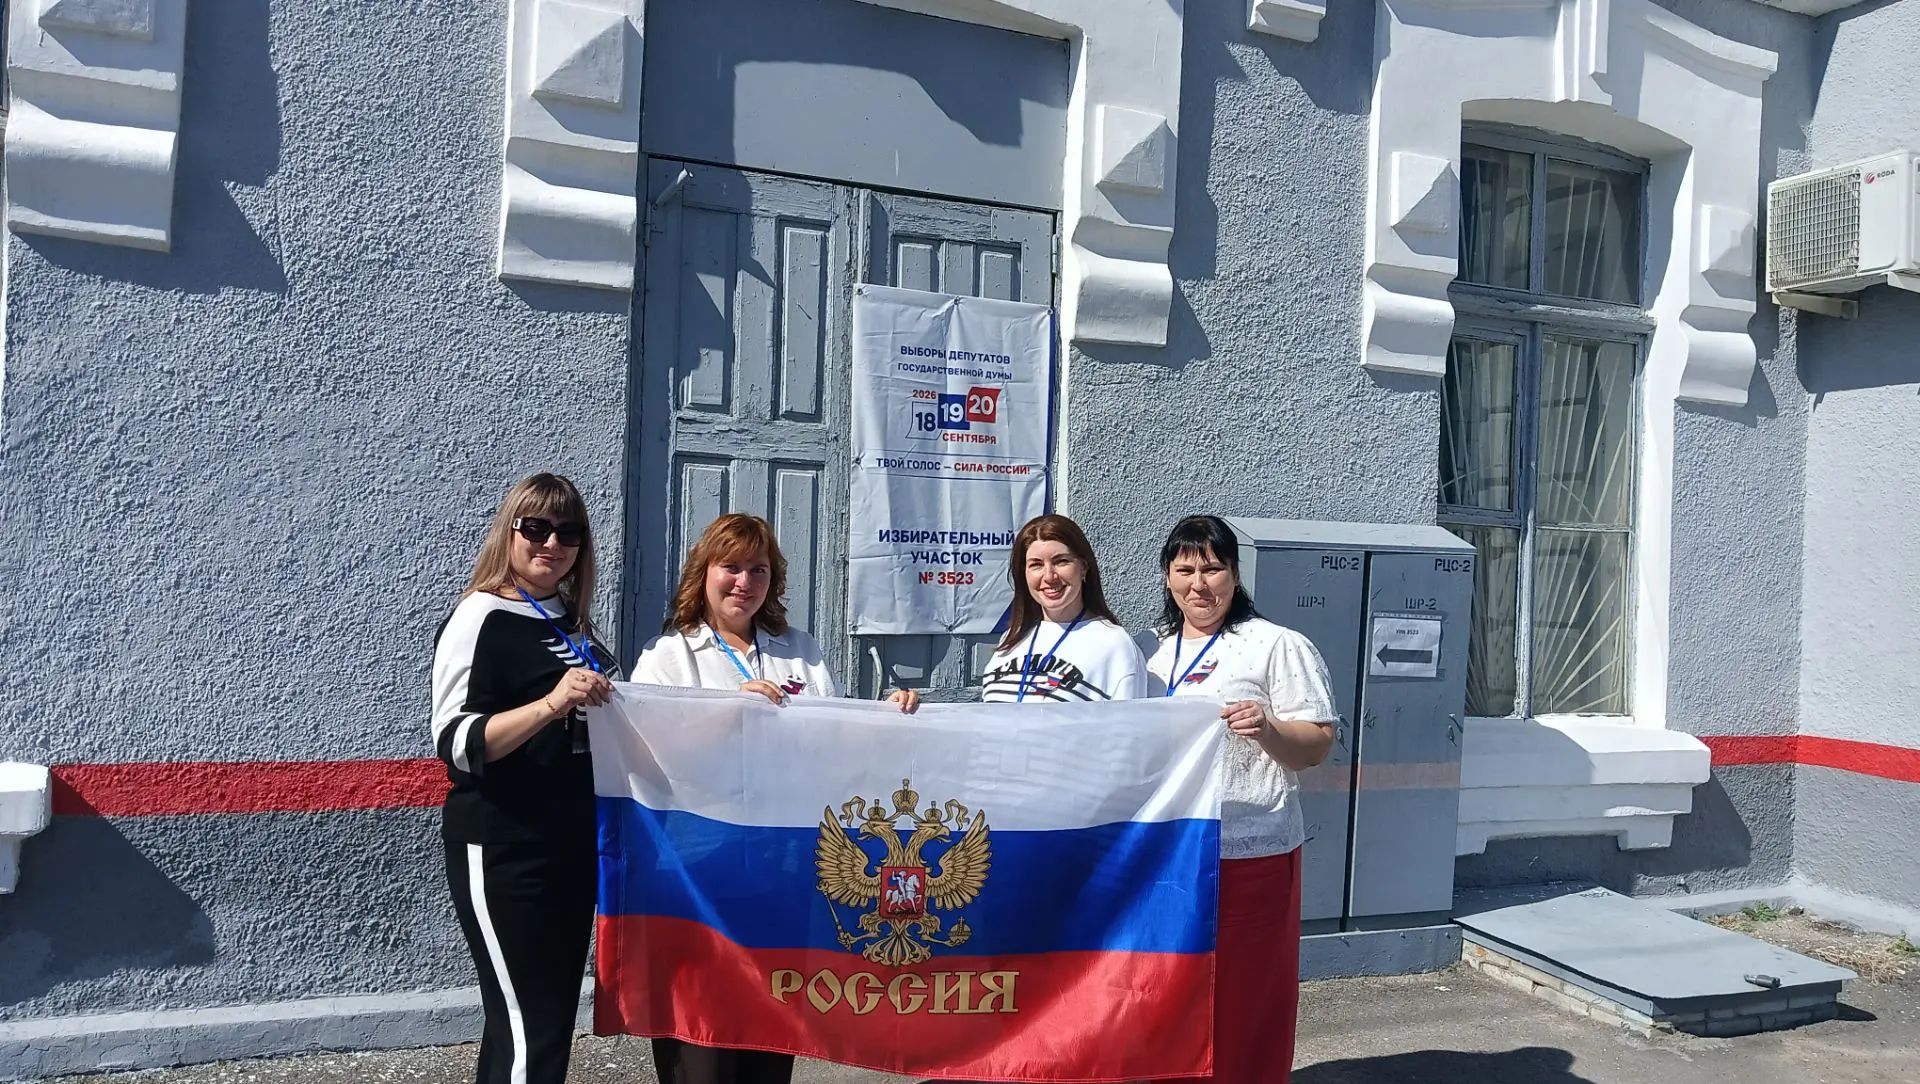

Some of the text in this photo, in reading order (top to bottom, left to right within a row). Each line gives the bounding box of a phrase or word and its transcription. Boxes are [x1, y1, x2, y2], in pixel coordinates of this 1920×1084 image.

[901, 346, 1010, 364] ВЫБОРЫ ДЕПУТАТОВ
[898, 363, 1012, 380] ГОСУДАРСТВЕННОЙ ДУМЫ
[912, 390, 936, 399] 2026
[915, 395, 994, 431] 18 19 20
[942, 433, 996, 444] СЕНТЯБРЯ
[876, 457, 904, 469] ТВОЙ
[907, 460, 941, 471] ГОЛОС
[954, 463, 983, 473] СИЛА
[986, 464, 1030, 475] РОССИИ!
[879, 529, 1015, 546] ИЗБИРАТЕЛЬНЫЙ
[911, 551, 983, 565] УЧАСТОК
[1321, 556, 1360, 571] РЦС-2
[1435, 559, 1471, 572] РЦС-2
[918, 572, 974, 585] № 3523
[1297, 596, 1325, 608] ШР-1
[1405, 597, 1437, 610] ШР-2
[769, 968, 1020, 1016] РОССИЯ
